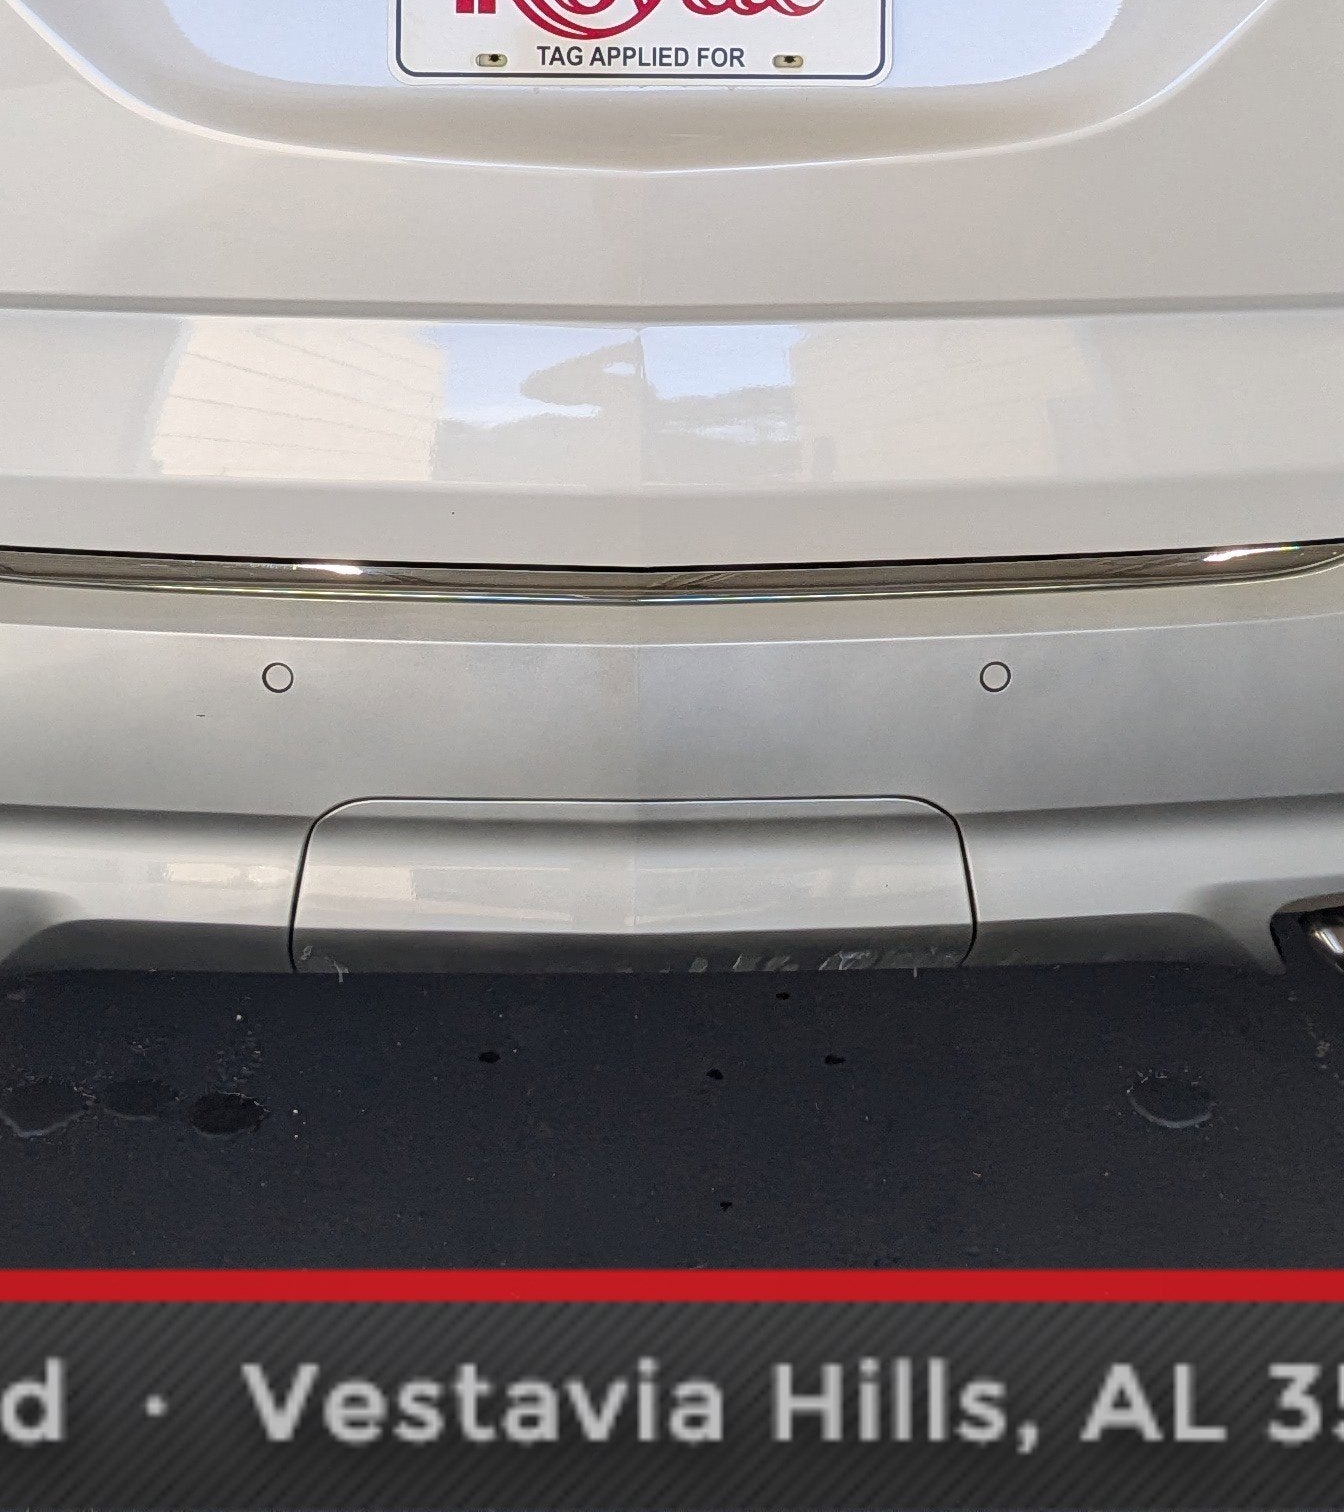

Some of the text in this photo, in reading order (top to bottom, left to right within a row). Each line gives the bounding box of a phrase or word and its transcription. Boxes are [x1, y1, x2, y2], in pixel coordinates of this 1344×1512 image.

[537, 45, 745, 68] TAG APPLIED FOR
